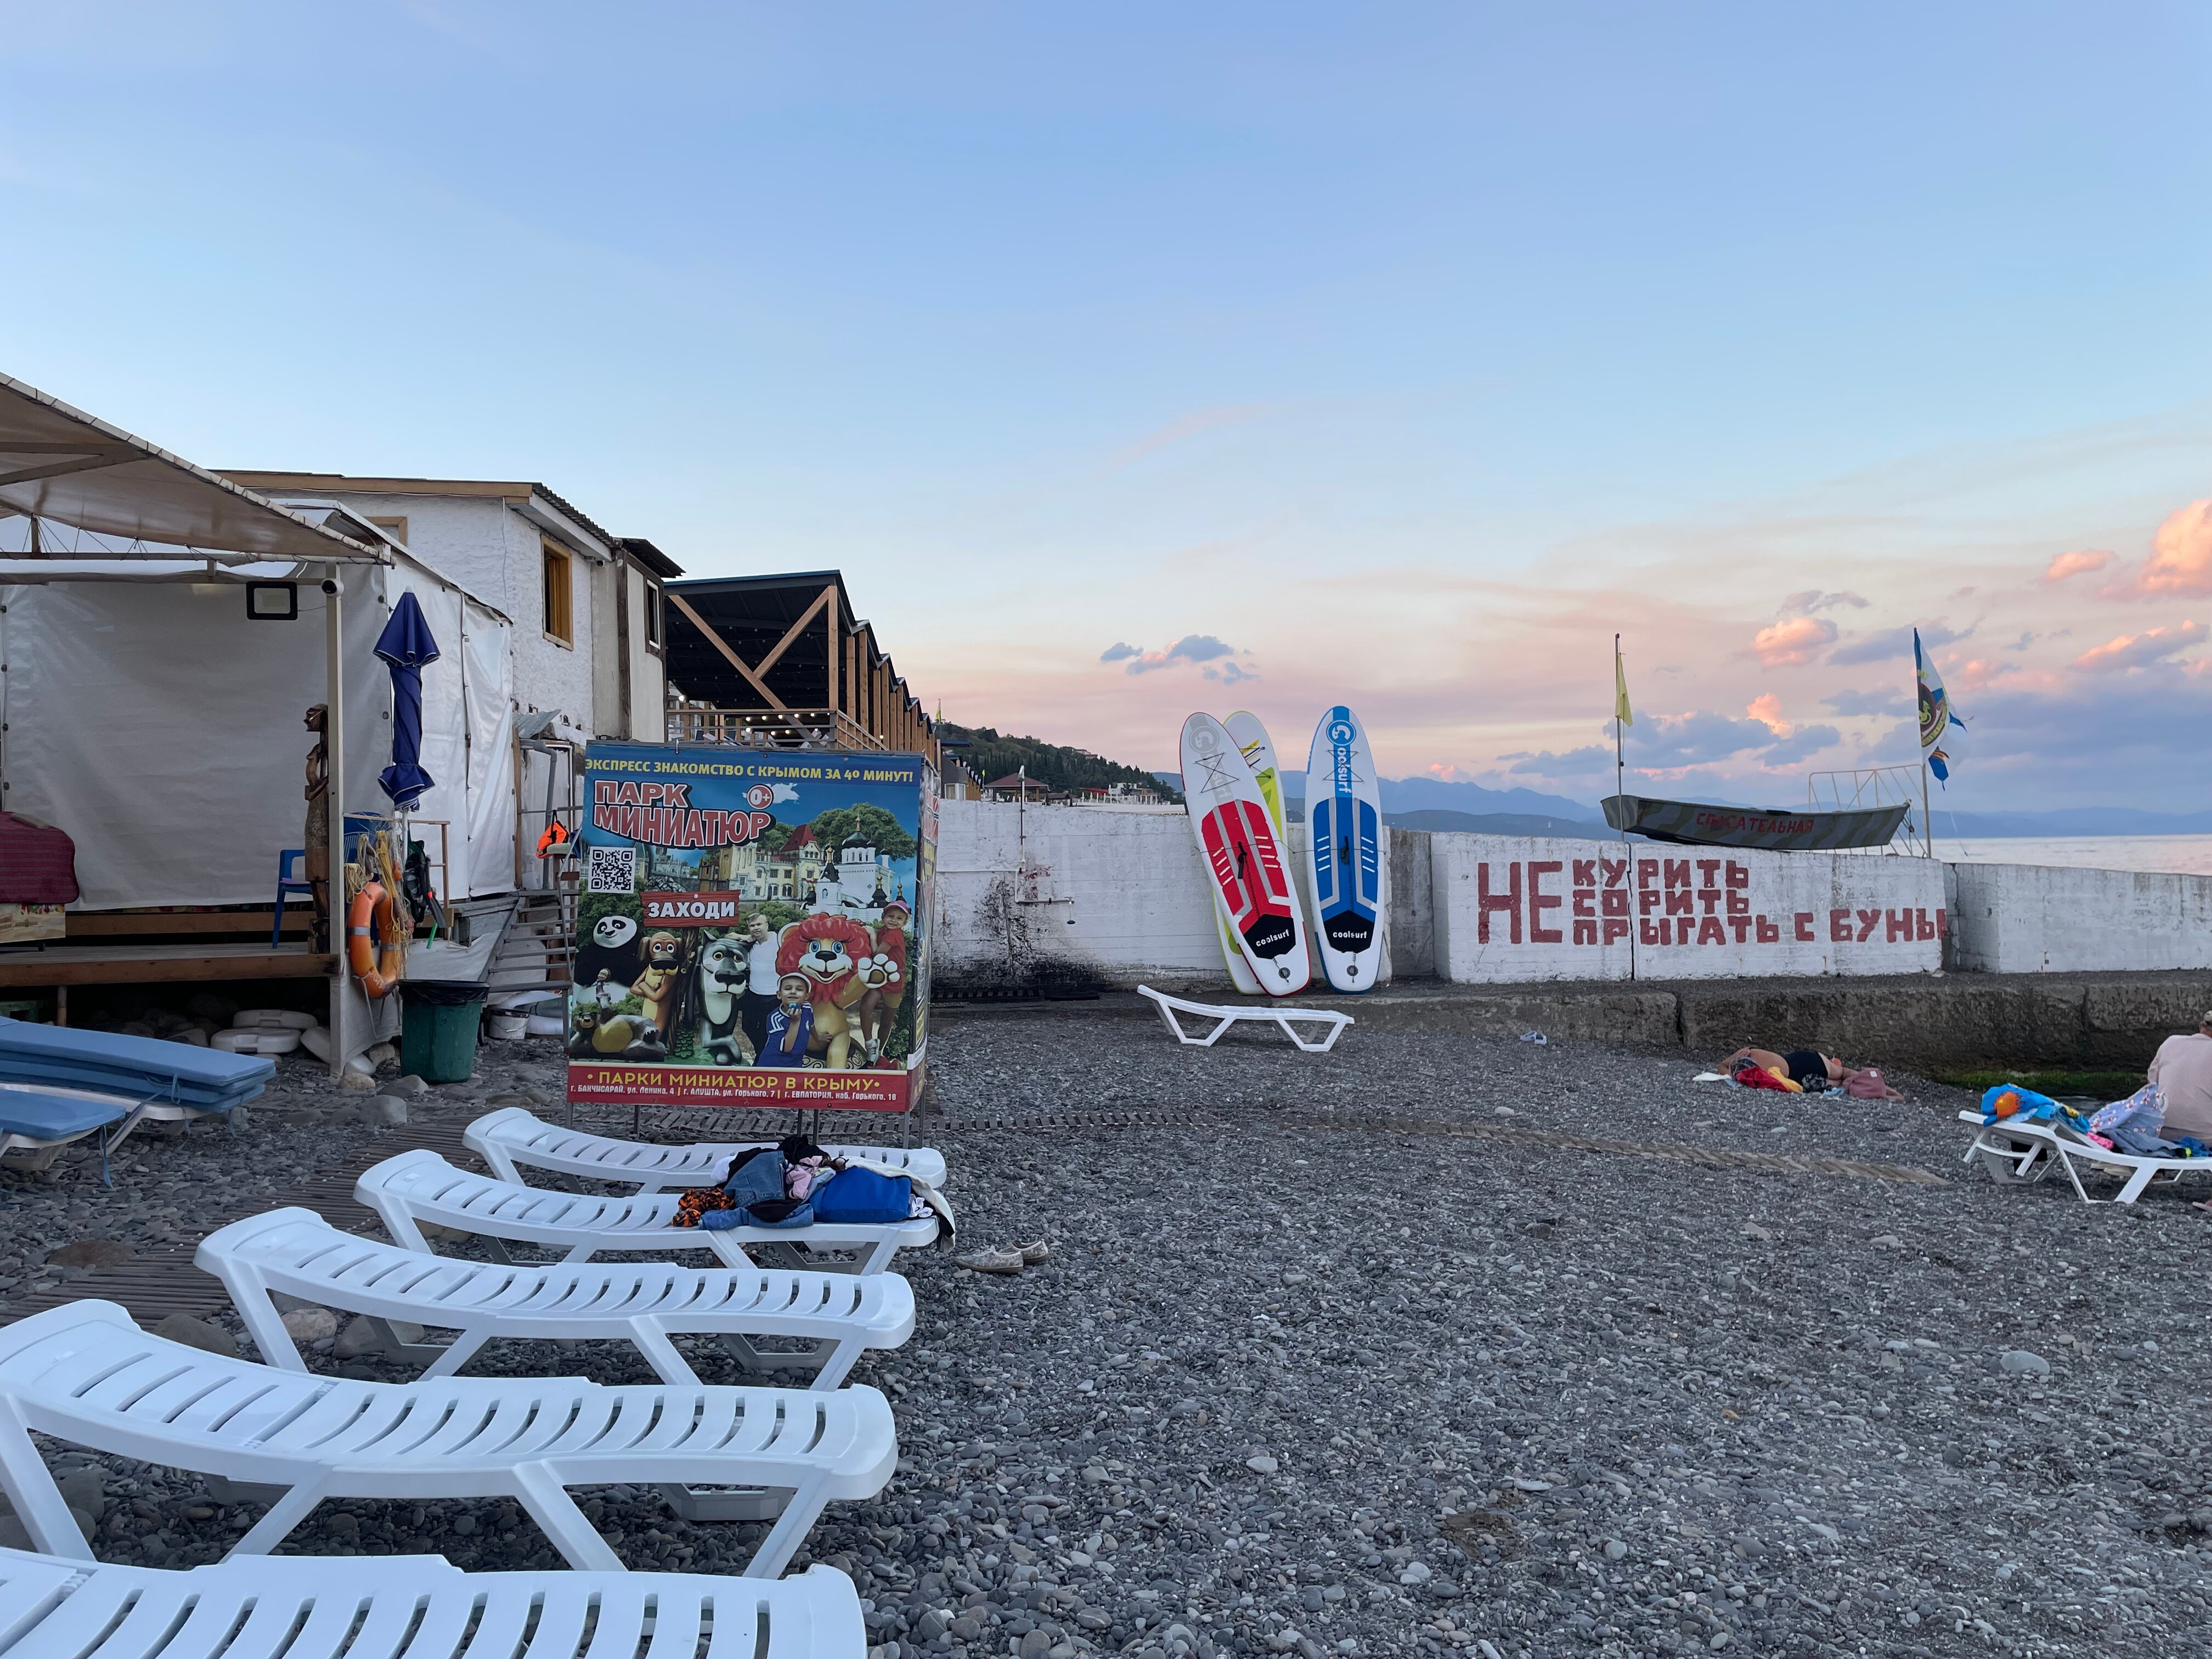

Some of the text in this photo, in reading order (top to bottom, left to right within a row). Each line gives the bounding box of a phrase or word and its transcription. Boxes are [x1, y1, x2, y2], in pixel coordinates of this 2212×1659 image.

[585, 759, 913, 782] ЭКСПРЕСС ЗНАКОМСТВО С КРЫМОМ ЗА 40 МИНУТ!
[594, 780, 689, 808] ПАРК
[750, 788, 770, 805] 0+
[594, 804, 771, 847] МИНИАТЮР
[1572, 859, 1749, 889] КУРИТЬ
[647, 901, 735, 920] ЗАХОДИ
[1477, 861, 1563, 945] НЕ
[1573, 889, 1749, 917] СОРИТЬ
[1255, 929, 1290, 947] coolsurf
[1332, 930, 1368, 939] coolsurf
[1573, 908, 1946, 946] ПРЫГАТЬ С БУНЫ
[599, 1071, 874, 1091] ПАРКИ МИНИАТЮР В КРЫМУ
